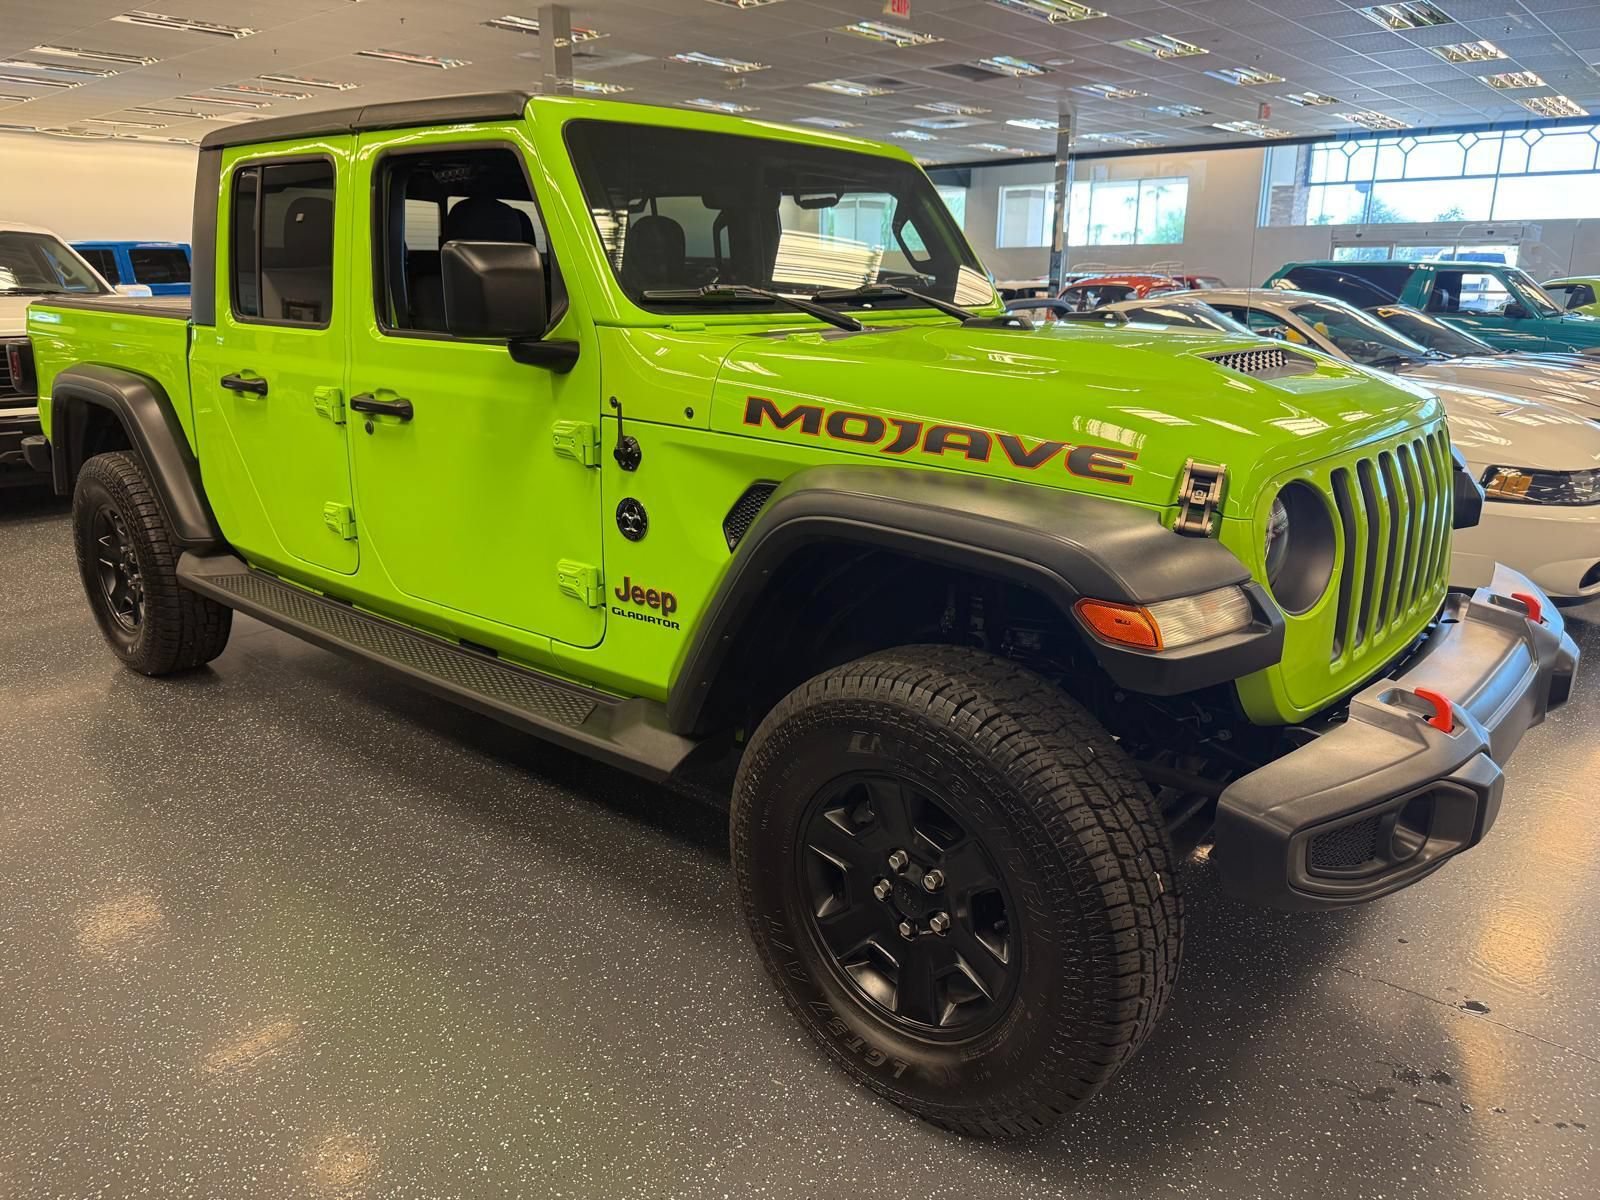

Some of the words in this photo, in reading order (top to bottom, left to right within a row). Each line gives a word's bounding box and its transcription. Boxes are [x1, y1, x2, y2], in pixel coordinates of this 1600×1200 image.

[743, 396, 1138, 485] MOJAVE
[614, 576, 677, 617] Jeep
[611, 606, 680, 630] GLADIATOR
